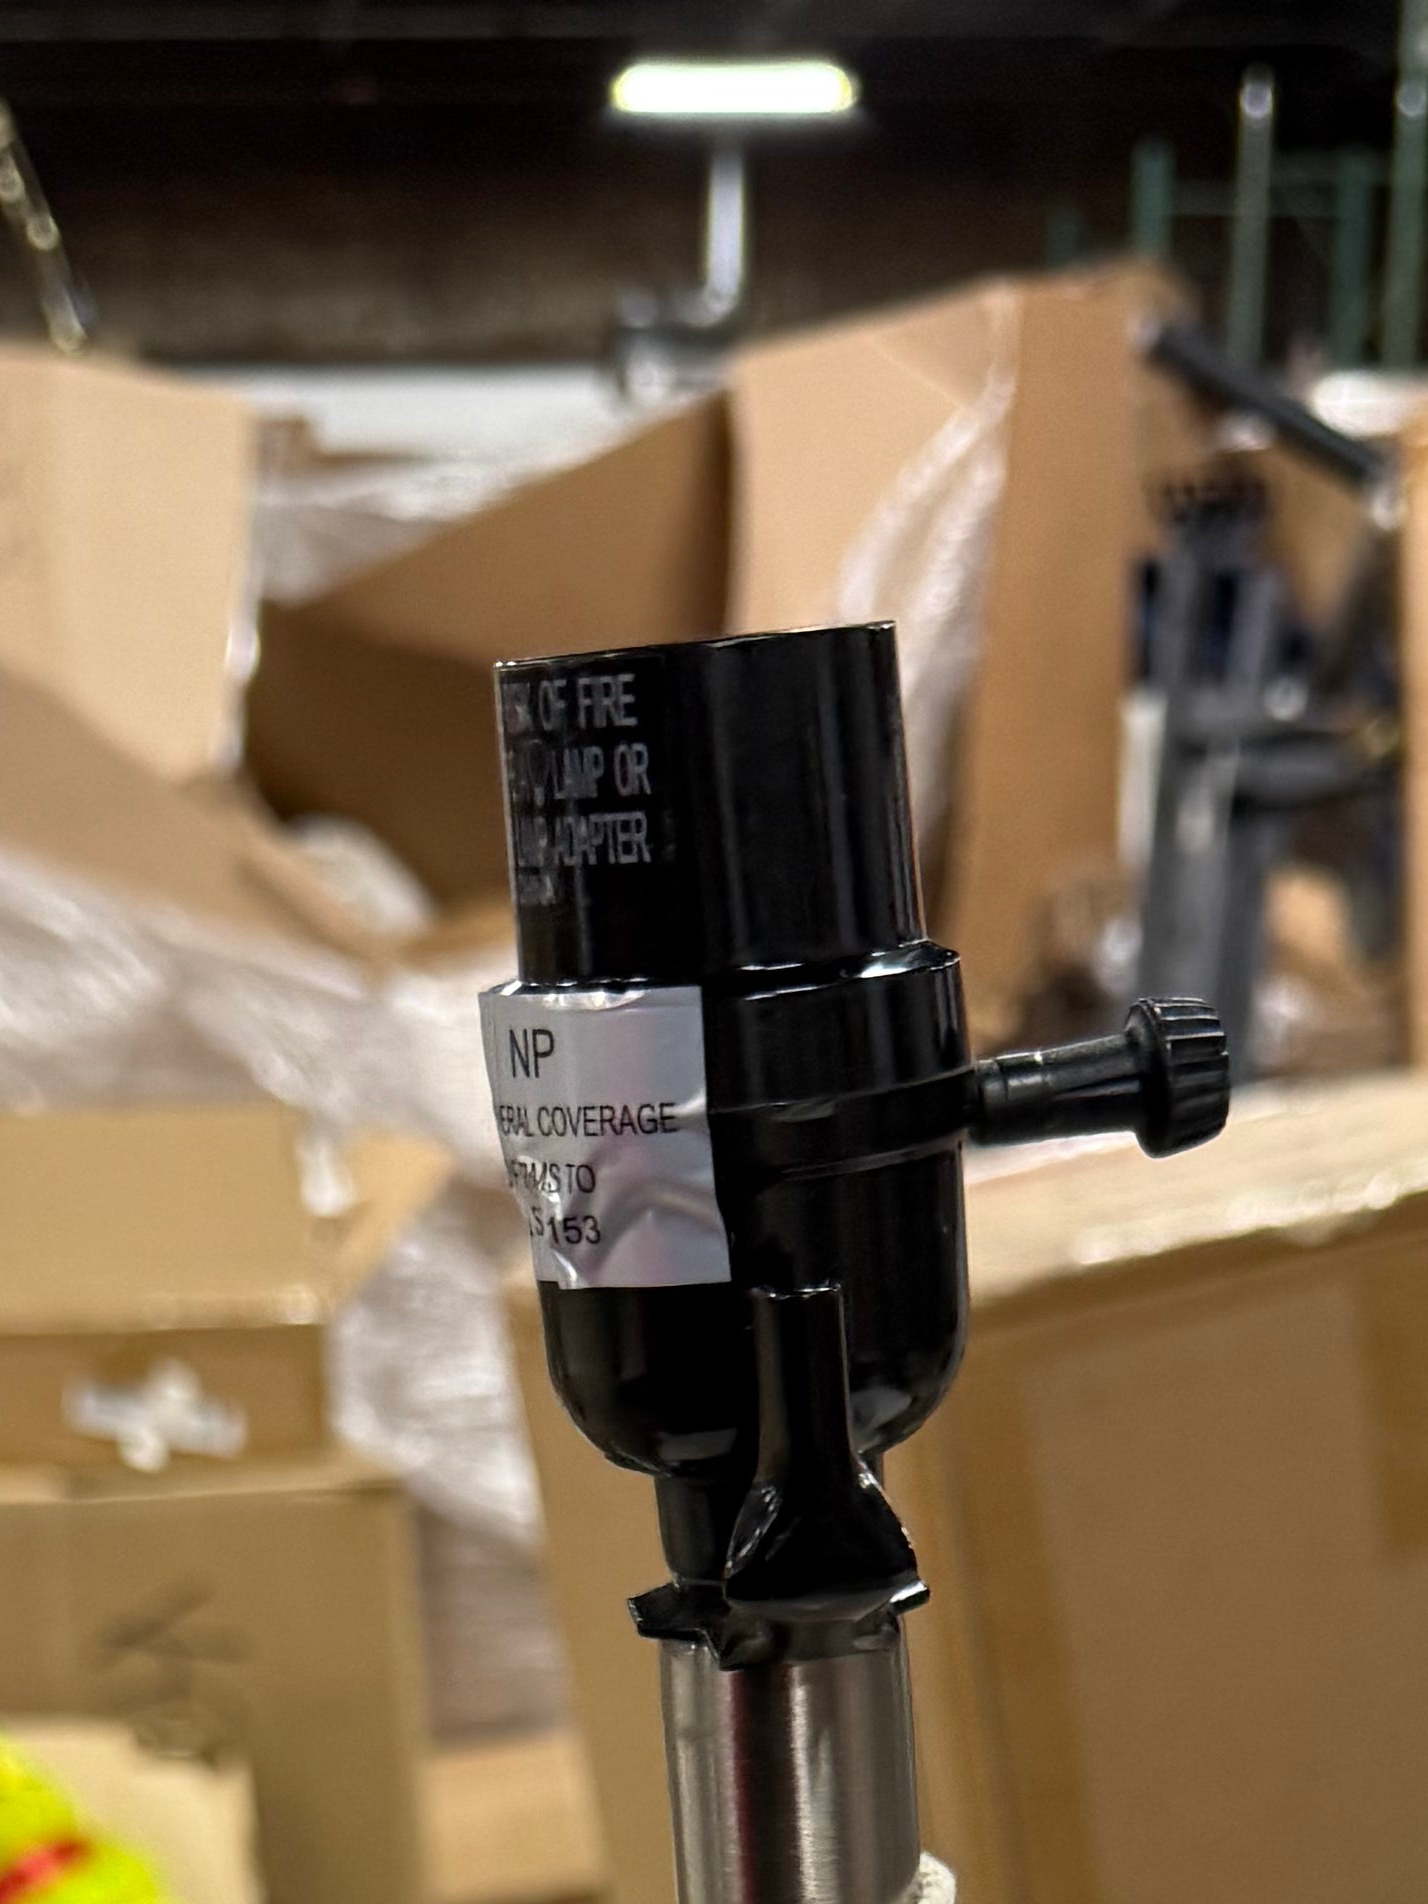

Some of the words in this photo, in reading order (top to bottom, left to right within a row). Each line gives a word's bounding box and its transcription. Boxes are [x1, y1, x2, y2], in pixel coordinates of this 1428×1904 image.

[538, 679, 567, 731] OF
[614, 742, 652, 796] OR
[509, 1028, 555, 1078] NP
[537, 1102, 681, 1138] COVERAGE
[564, 1162, 597, 1194] TO
